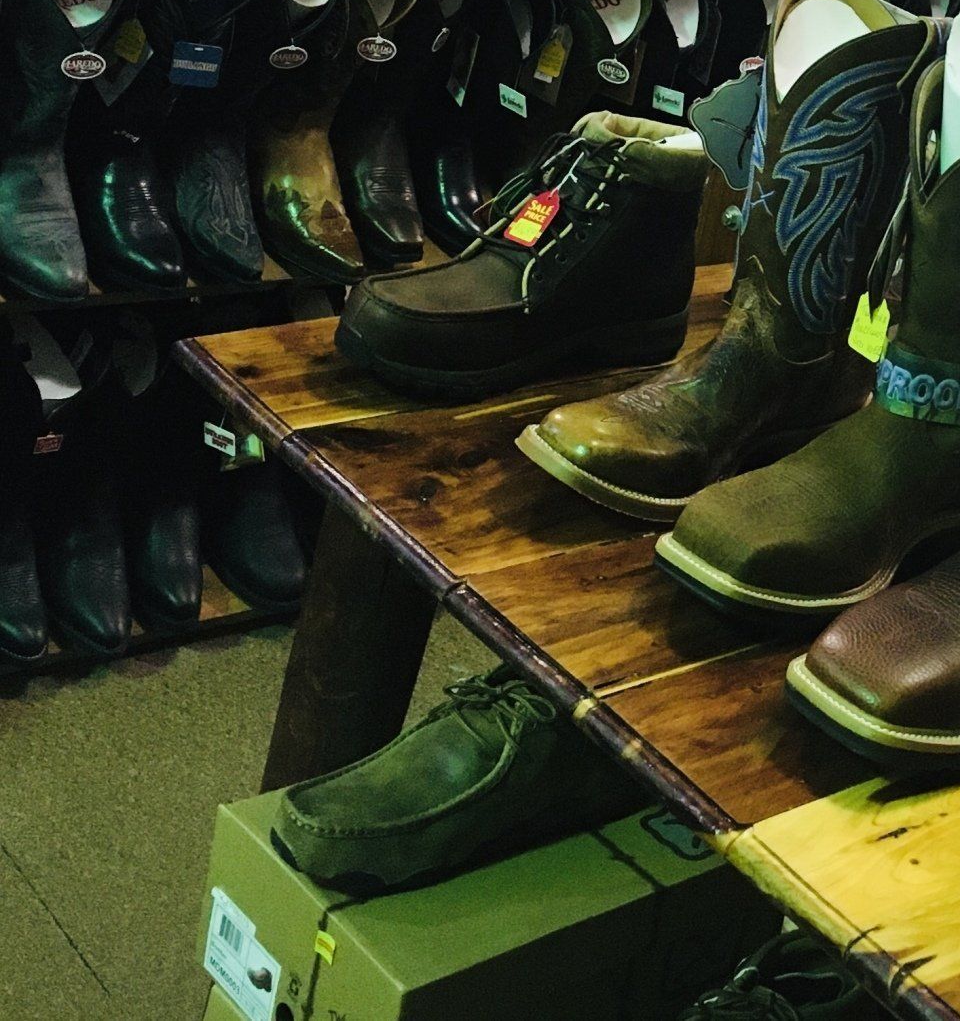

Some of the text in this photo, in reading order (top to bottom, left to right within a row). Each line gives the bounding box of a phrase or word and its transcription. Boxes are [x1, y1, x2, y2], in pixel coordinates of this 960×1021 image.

[65, 60, 101, 71] LAREDO
[527, 200, 555, 216] SALE
[523, 210, 547, 223] PRICE
